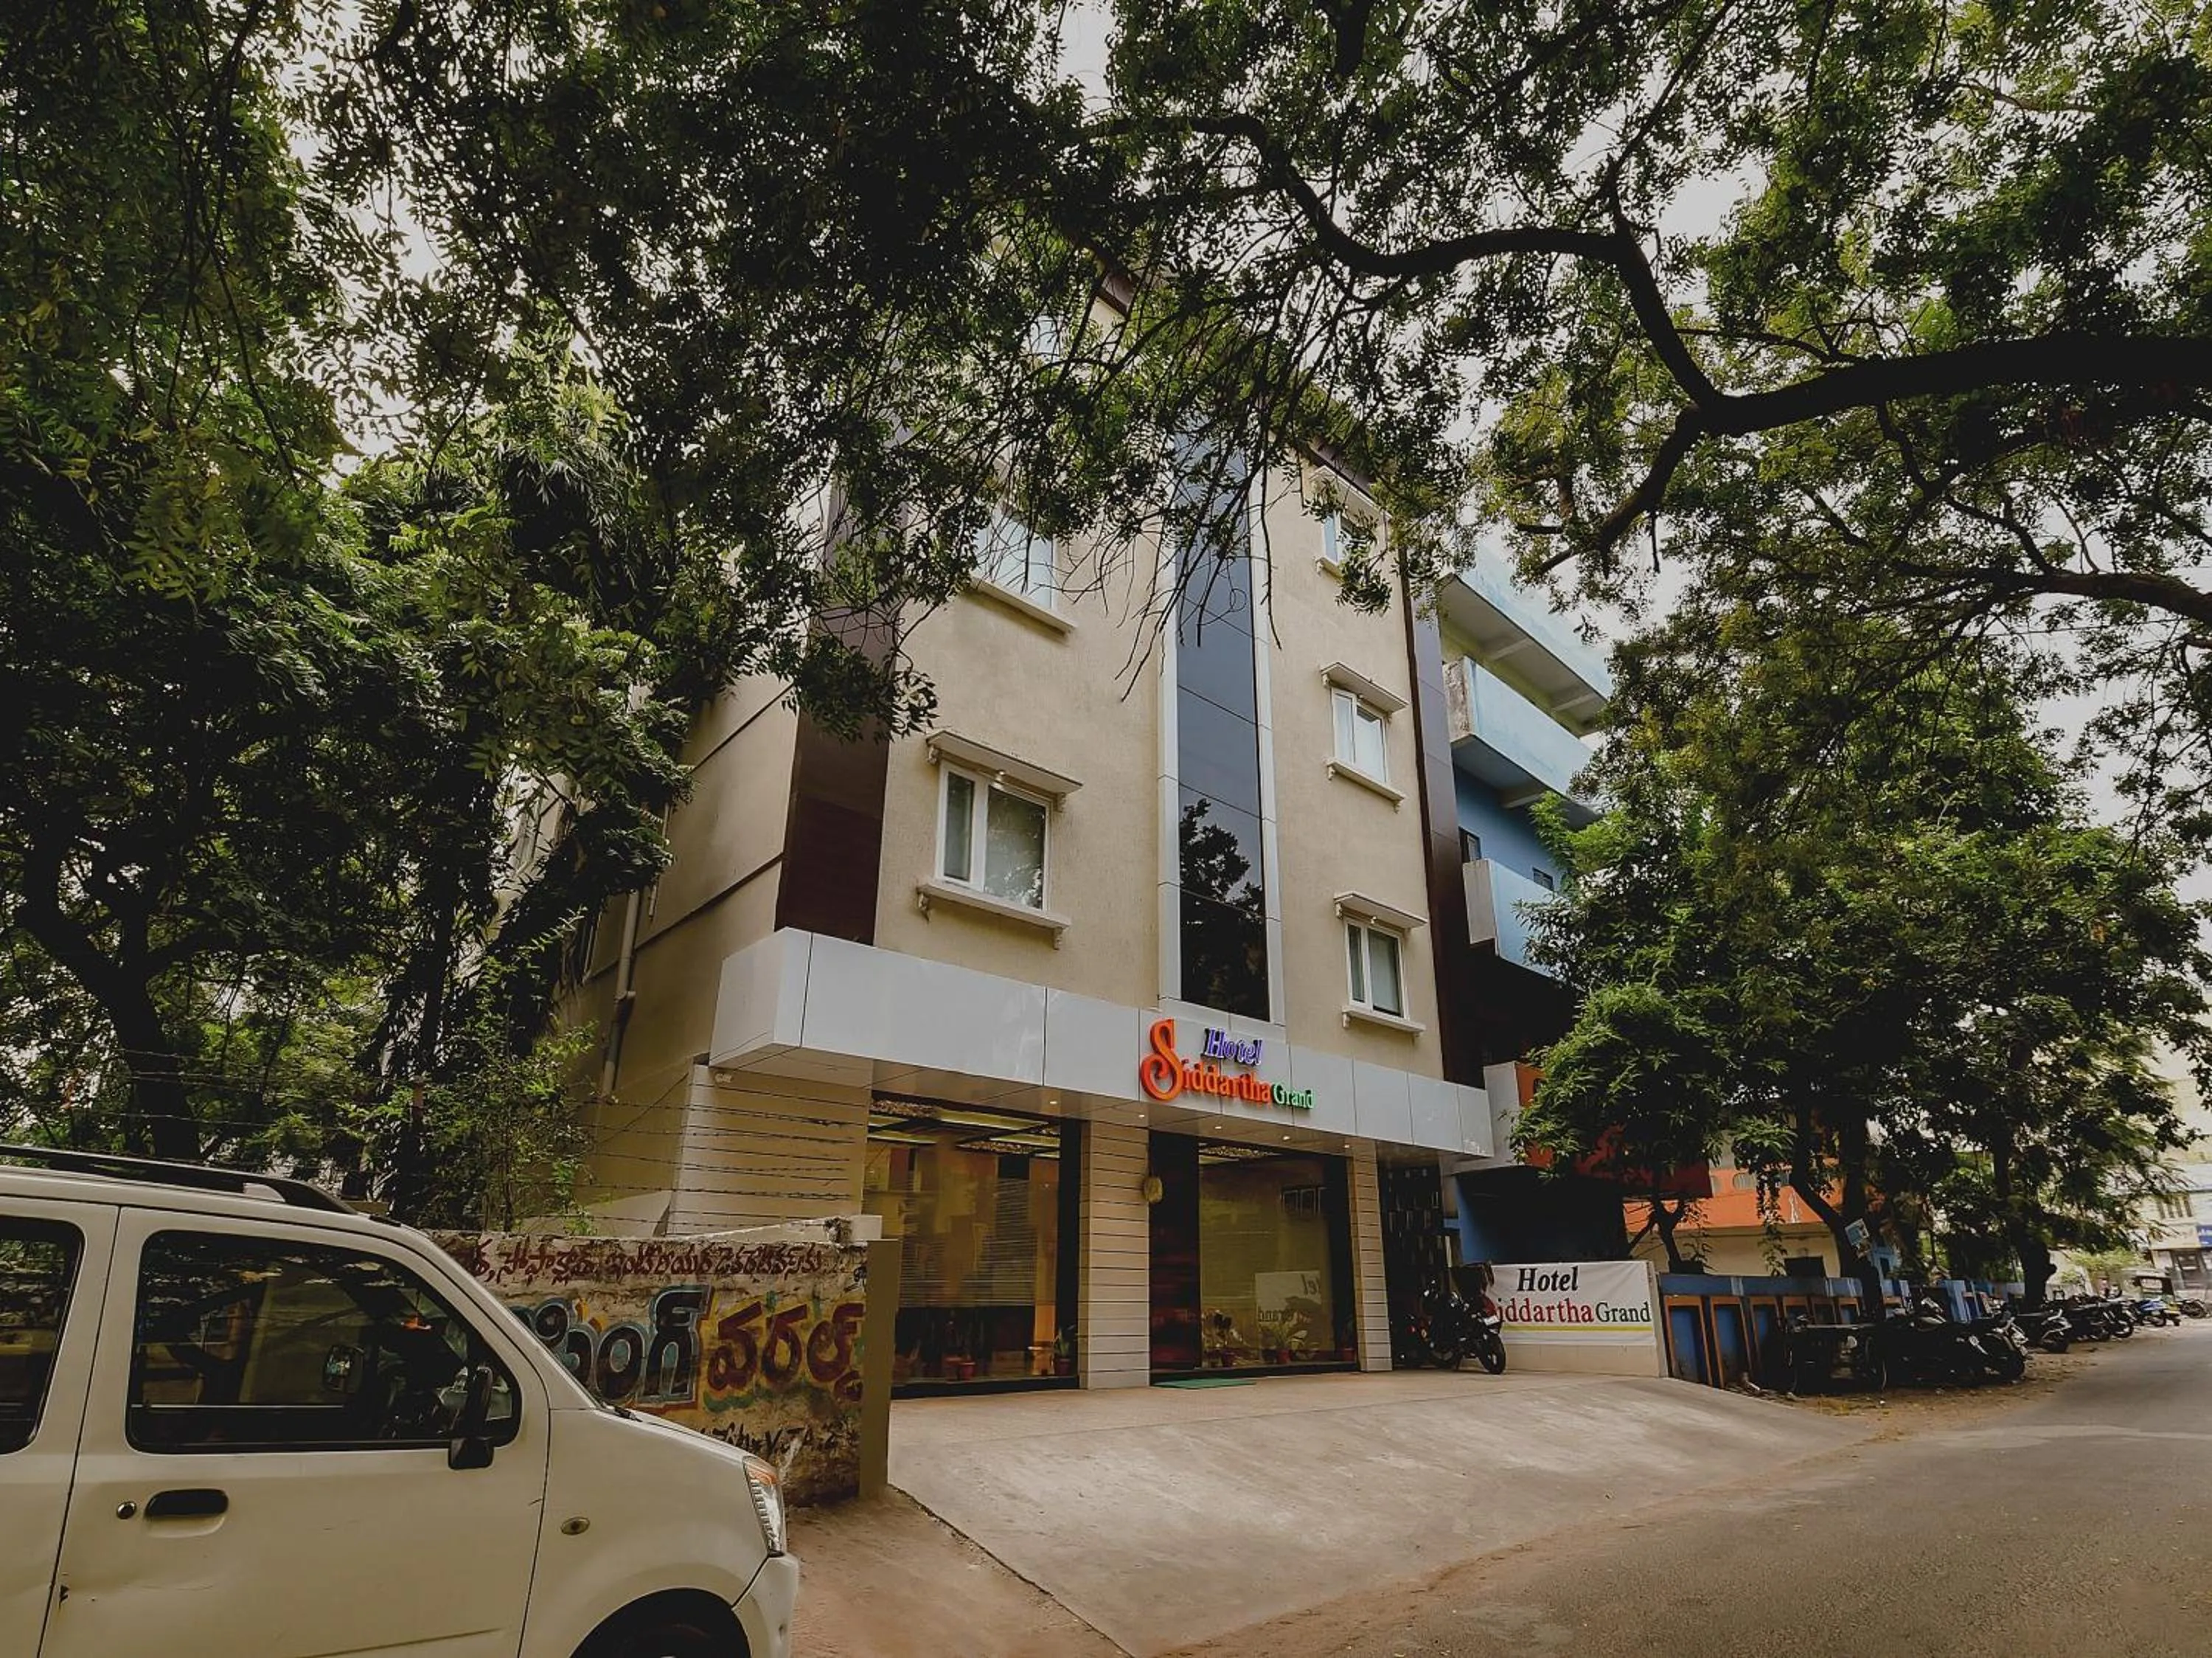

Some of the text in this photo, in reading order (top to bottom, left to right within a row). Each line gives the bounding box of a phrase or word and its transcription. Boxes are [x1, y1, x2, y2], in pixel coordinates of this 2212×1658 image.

[1201, 1027, 1262, 1065] Hotel
[1141, 1019, 1315, 1109] Siddartha Grand
[1517, 1266, 1579, 1291] Hotel
[1498, 1297, 1594, 1322] iddartha
[1595, 1301, 1652, 1322] Grand
